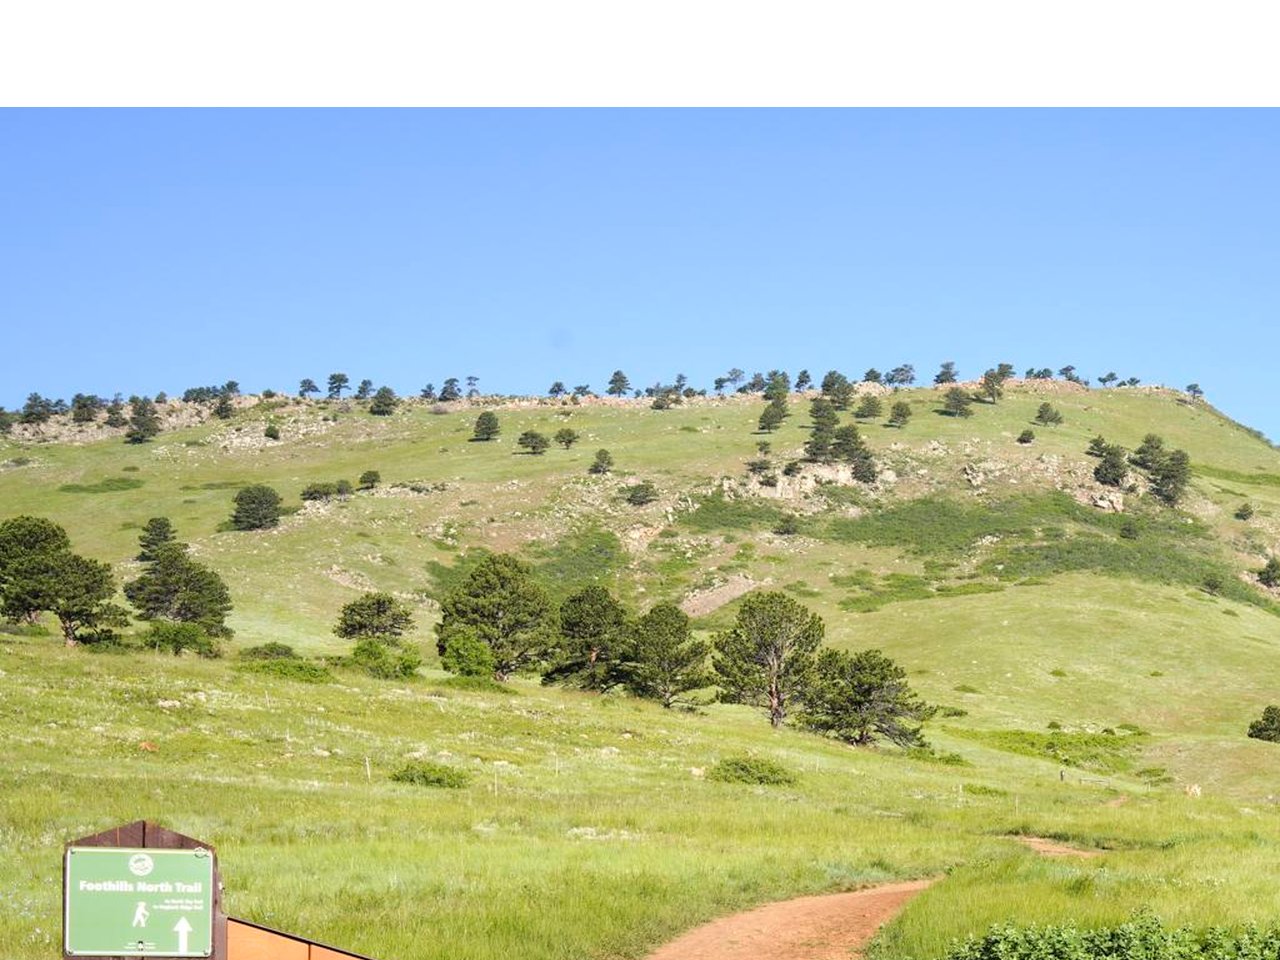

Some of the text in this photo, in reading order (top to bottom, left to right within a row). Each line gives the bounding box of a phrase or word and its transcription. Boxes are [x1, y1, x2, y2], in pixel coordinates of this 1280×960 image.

[80, 880, 202, 893] Foothills North Trail
